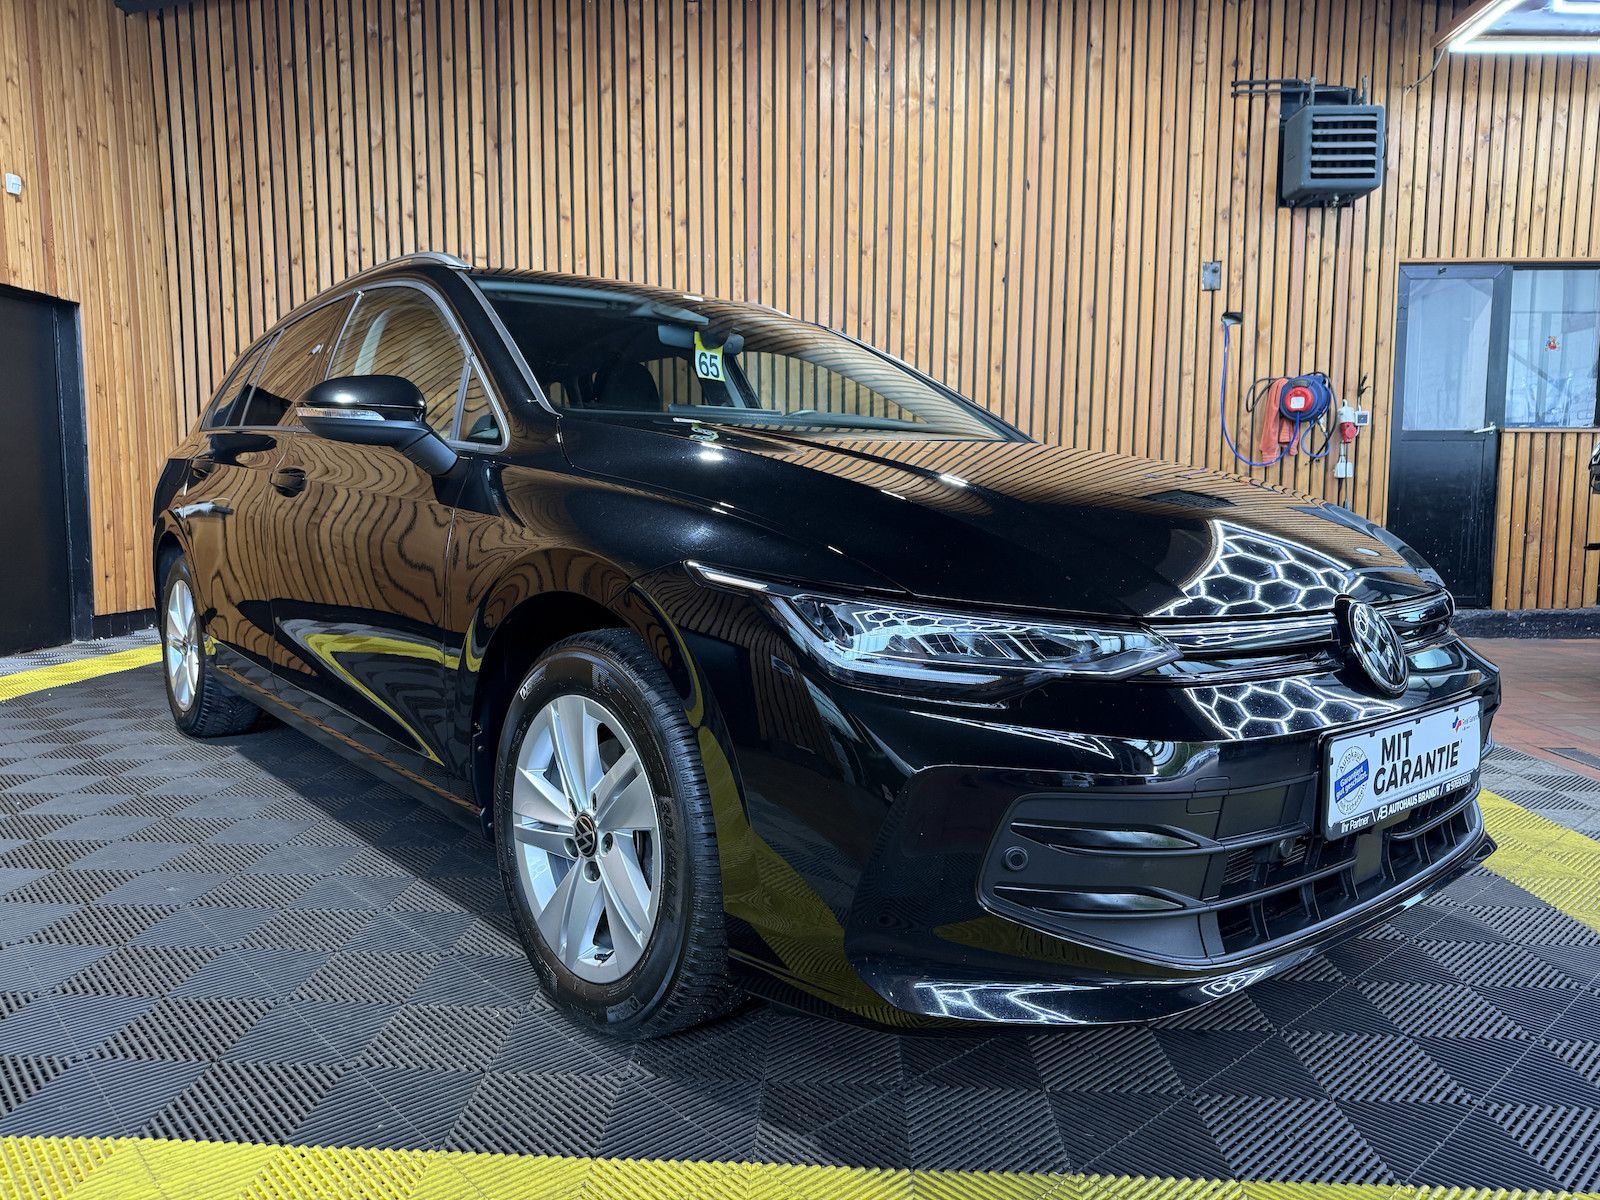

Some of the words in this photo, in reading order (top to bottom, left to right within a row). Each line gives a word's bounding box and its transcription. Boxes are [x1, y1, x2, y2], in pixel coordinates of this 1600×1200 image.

[699, 352, 720, 378] 65
[1340, 749, 1365, 772] Autokauf
[1382, 730, 1412, 765] MIT
[1389, 795, 1418, 815] AUTOHAUS
[1418, 786, 1441, 804] BRANDT
[1350, 816, 1369, 830] Partner
